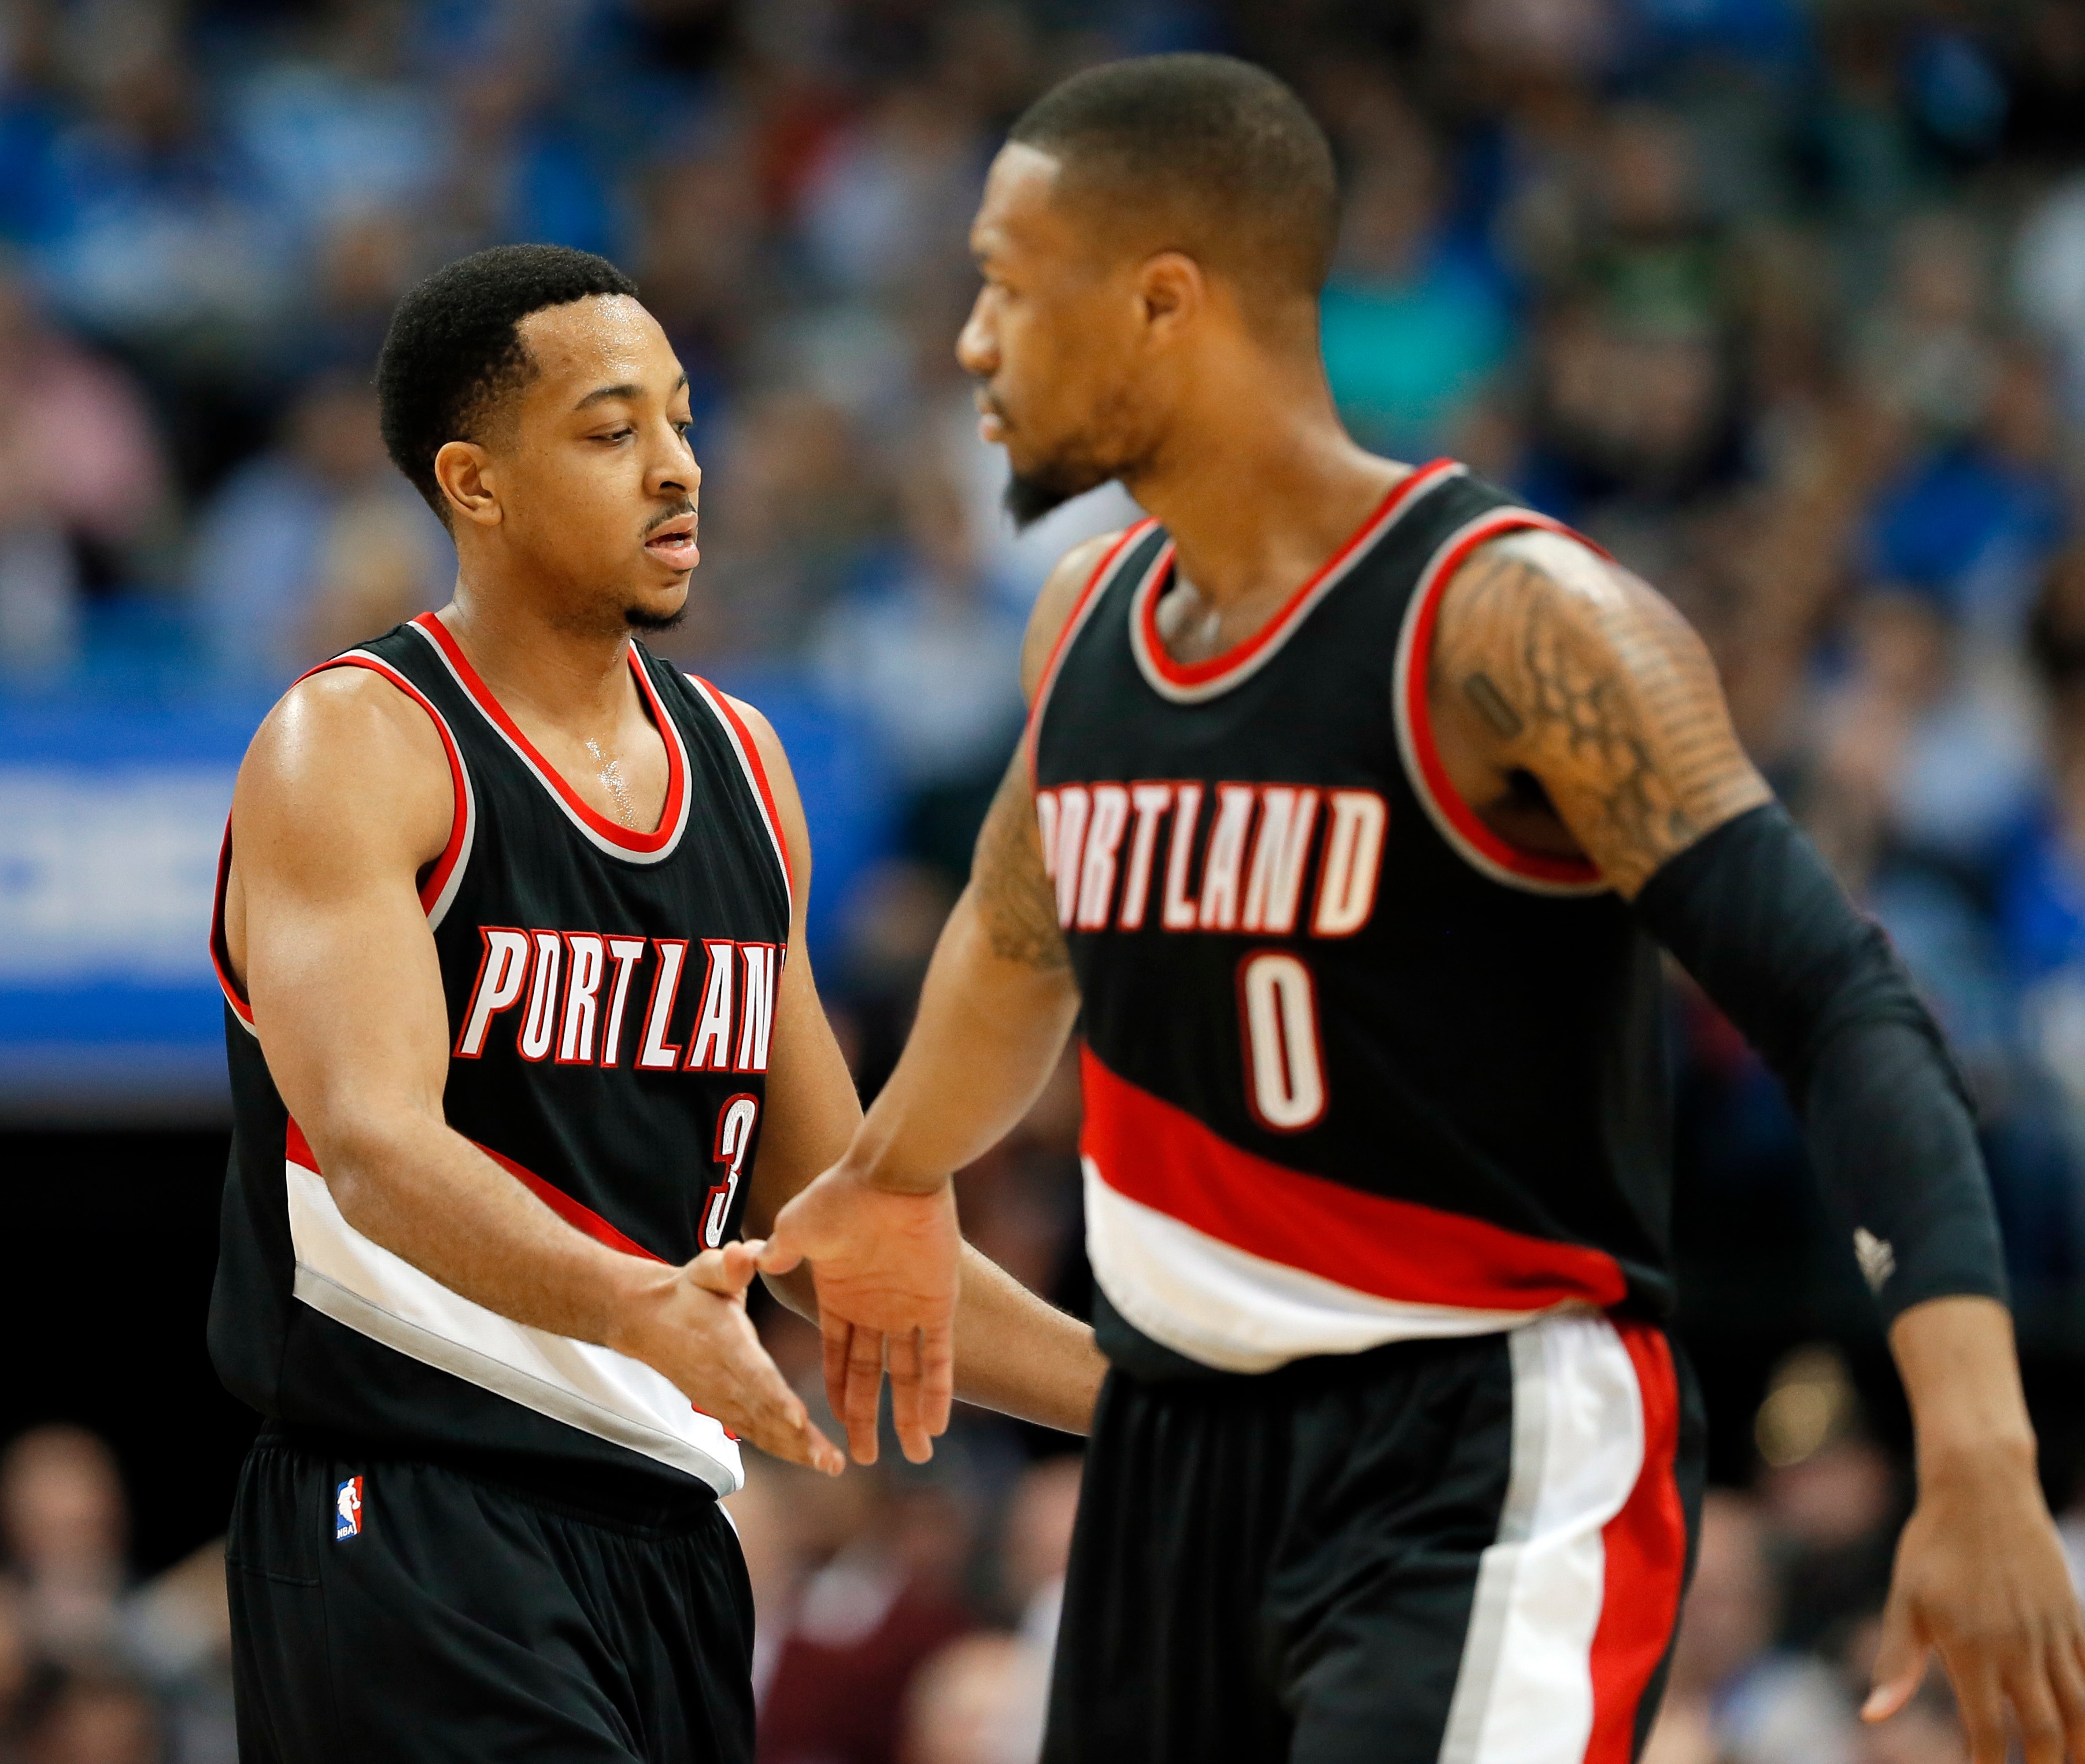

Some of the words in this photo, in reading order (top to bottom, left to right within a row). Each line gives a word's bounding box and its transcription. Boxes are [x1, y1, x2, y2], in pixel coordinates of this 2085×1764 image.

[453, 926, 787, 1074] PORTLAN
[1236, 948, 1328, 1133] 0
[697, 1093, 759, 1251] 3
[337, 1525, 354, 1539] NBA
